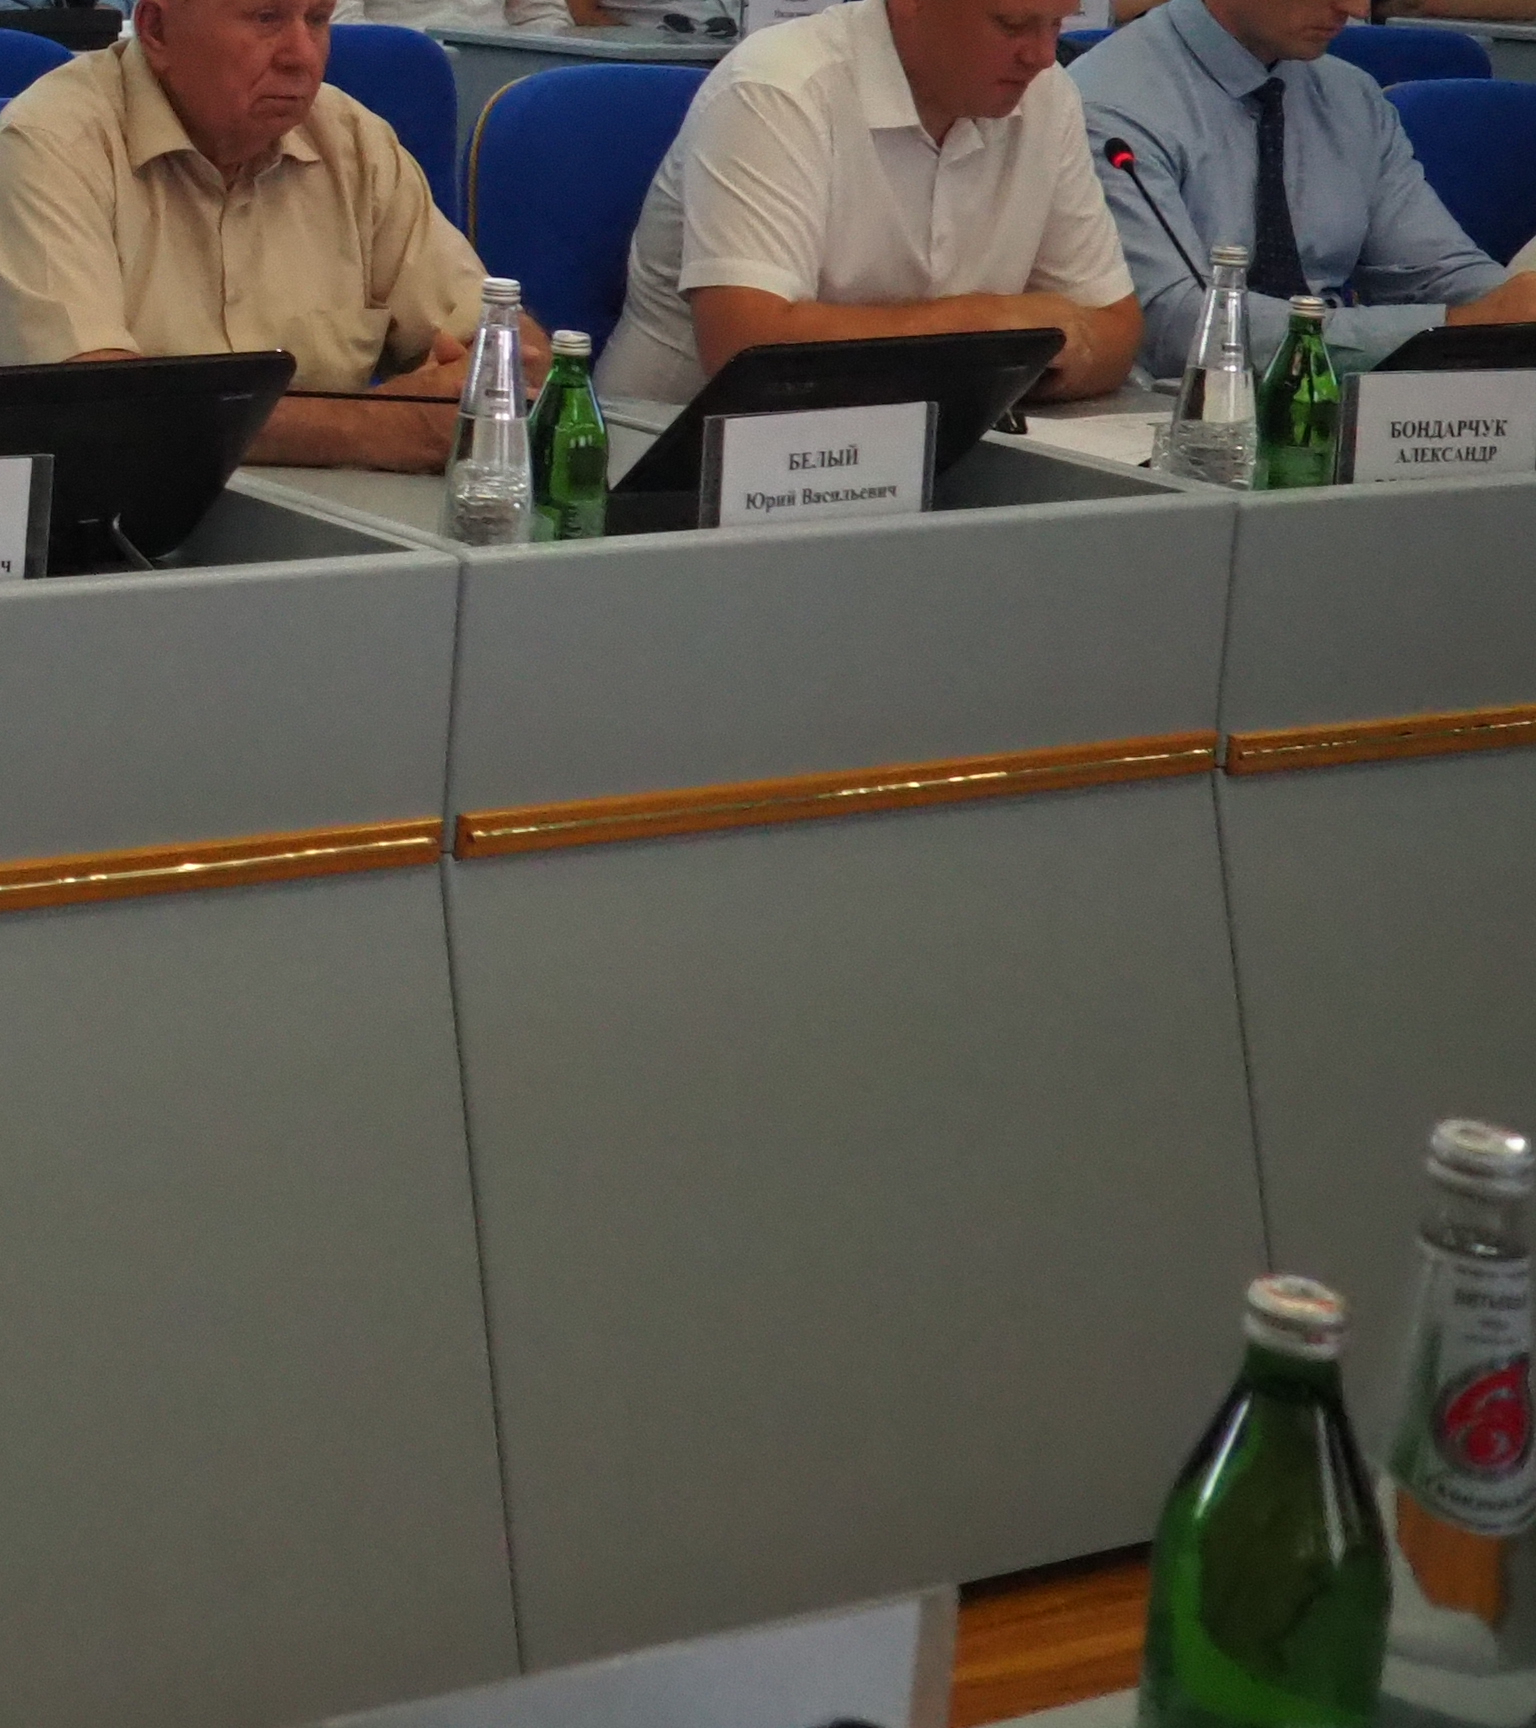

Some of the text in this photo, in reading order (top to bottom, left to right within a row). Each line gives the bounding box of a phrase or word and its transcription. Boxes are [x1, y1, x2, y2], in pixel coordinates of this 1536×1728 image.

[1390, 419, 1509, 440] БОНДАРЧУК
[788, 443, 859, 471] БЕЛЫЙ
[1394, 445, 1498, 464] АЛЕКСАНДР
[745, 485, 898, 513] Юрий Васильевич
